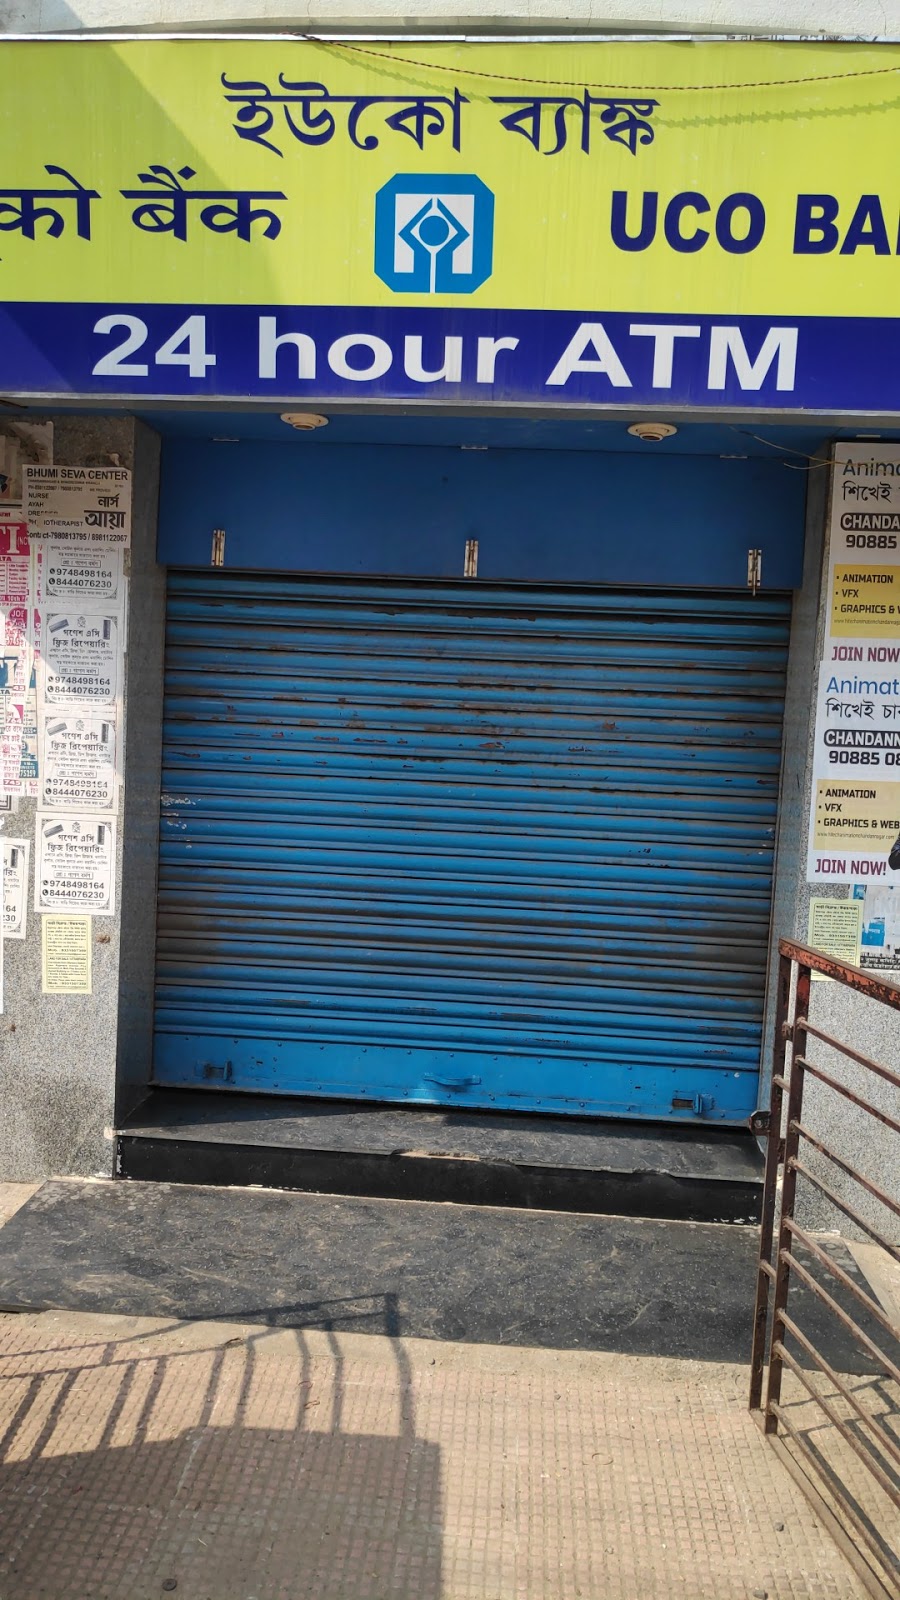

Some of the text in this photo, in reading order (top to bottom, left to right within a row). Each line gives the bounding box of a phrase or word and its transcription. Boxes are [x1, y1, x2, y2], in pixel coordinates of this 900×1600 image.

[221, 73, 661, 158] ইউকো ব্যাঙ্ক
[119, 165, 288, 243] बैंक
[611, 191, 900, 256] UCO BA
[92, 314, 799, 391] 24 hour ATM
[27, 468, 128, 480] BHUMI SEVA CENTER
[842, 480, 892, 503] শিখেই
[97, 493, 120, 508] নার্স
[83, 510, 127, 530] আয়া
[846, 534, 897, 549] 90885
[56, 568, 112, 578] 9748498164
[842, 574, 894, 584] ANIMATION
[56, 578, 112, 588] 8444076230
[841, 589, 859, 598] VFX
[840, 604, 895, 614] GRAPHICS &
[832, 646, 900, 662] JOIN NOW
[55, 676, 110, 686] 9748498164
[826, 675, 900, 695] Animat
[55, 686, 110, 695] 8444076230
[825, 697, 876, 720] শিখেই
[829, 750, 880, 765] 90885
[52, 788, 108, 798] 8444076230
[825, 789, 877, 799] ANIMATION
[824, 803, 842, 812] VFX
[823, 818, 869, 828] GRAPHICS
[871, 819, 878, 828] &
[815, 859, 887, 876] JOIN NOW!
[49, 880, 105, 889] 9748498164
[49, 889, 105, 899] 8444076230
